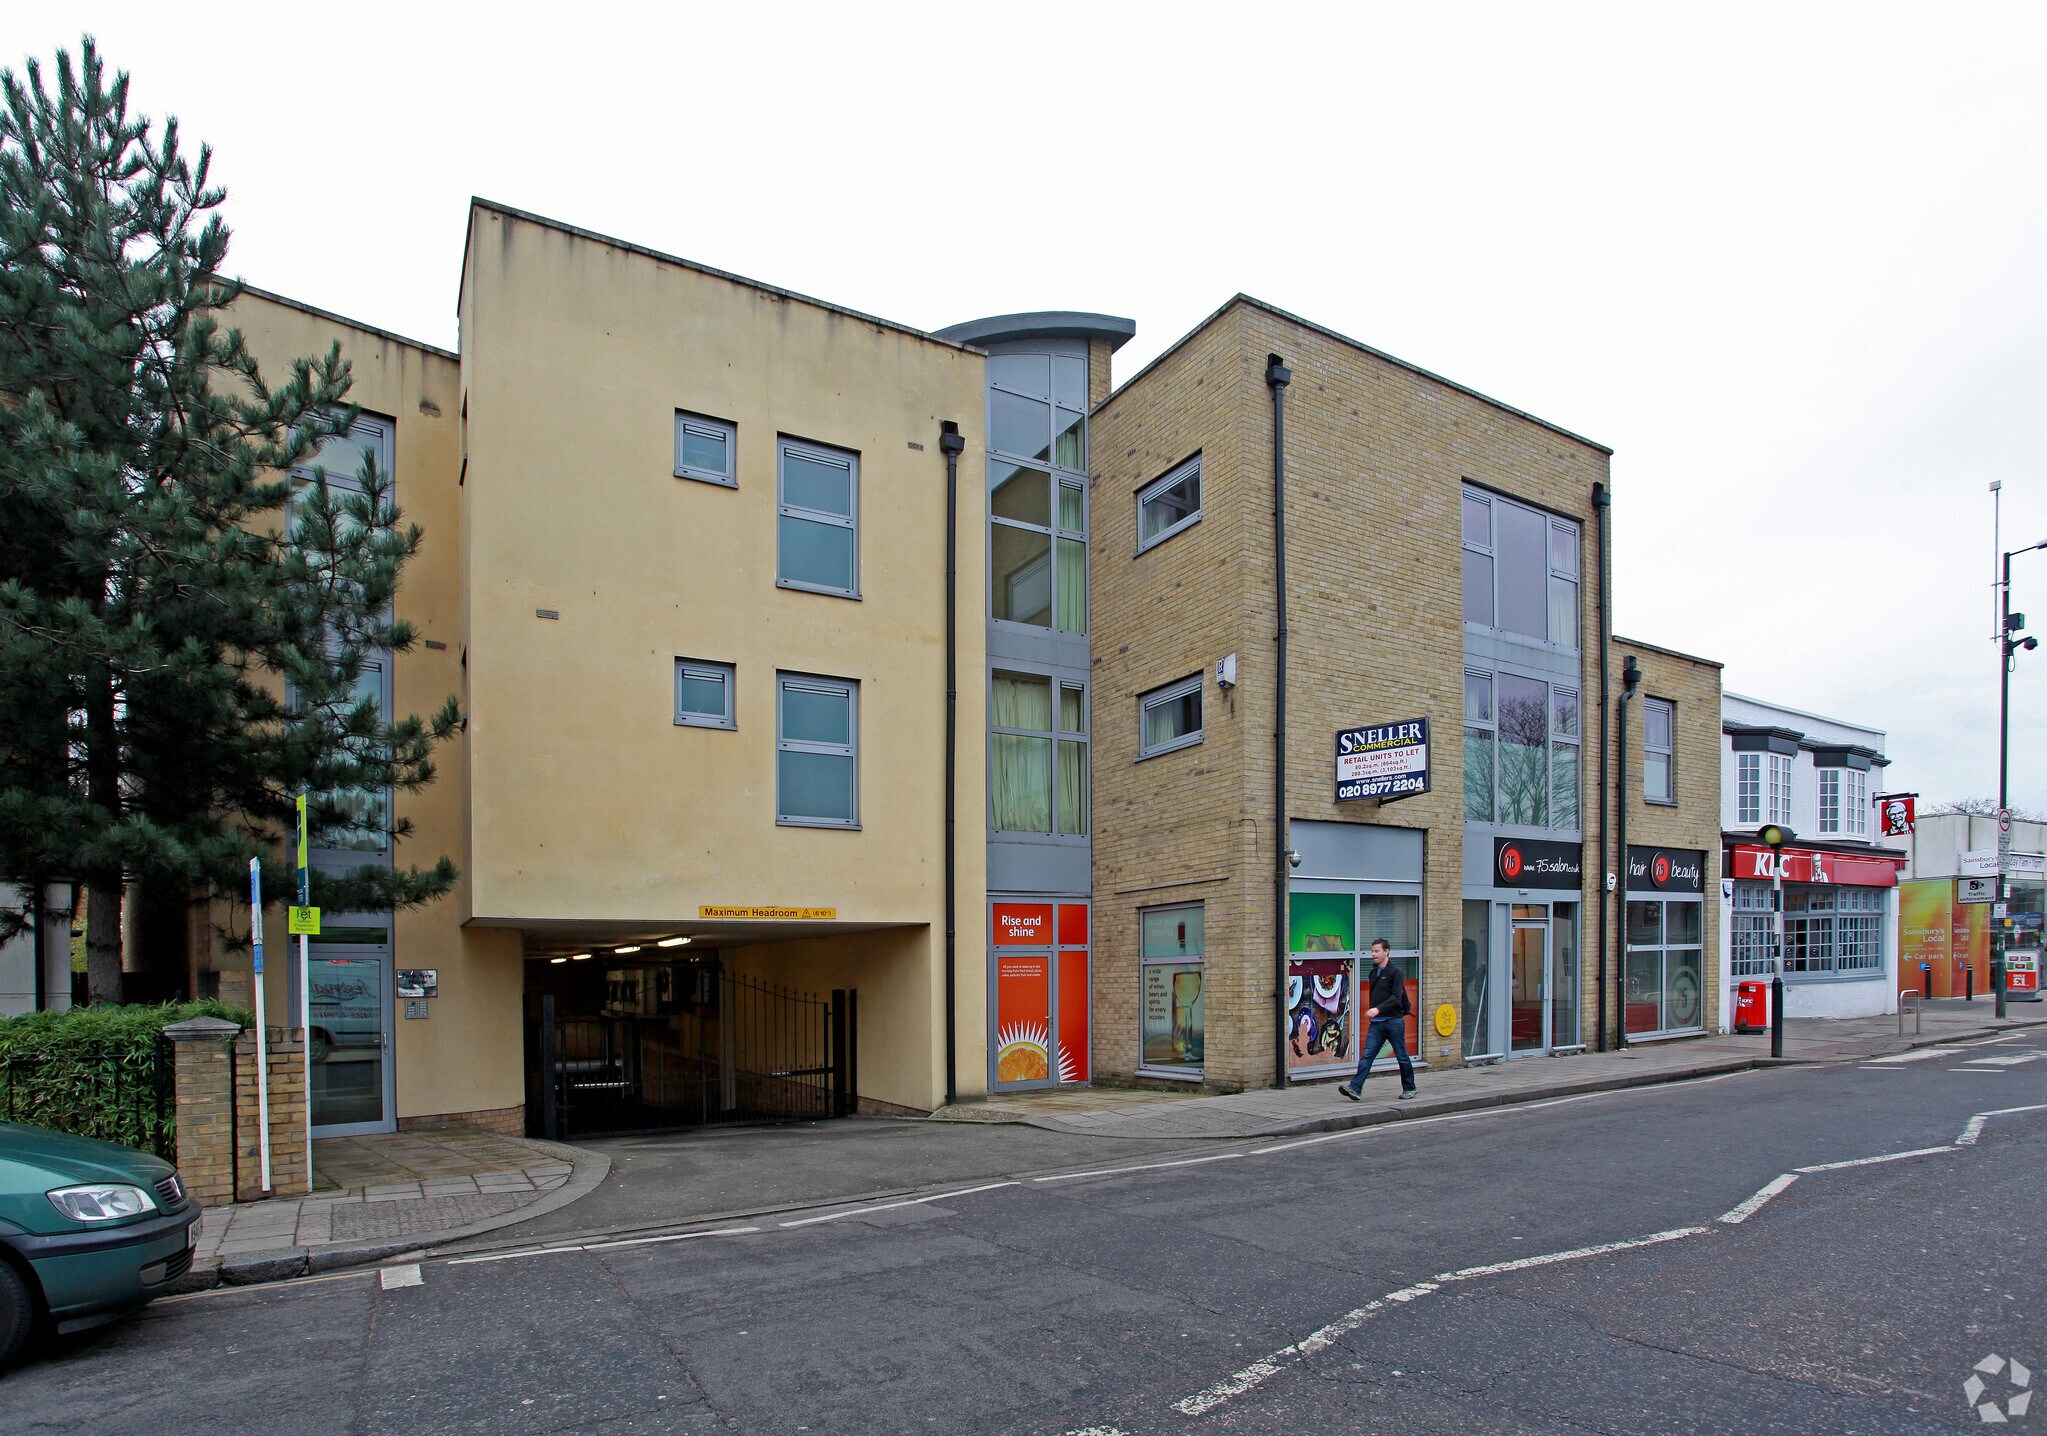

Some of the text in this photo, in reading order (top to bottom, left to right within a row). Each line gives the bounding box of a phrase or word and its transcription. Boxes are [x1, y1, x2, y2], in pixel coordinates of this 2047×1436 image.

[1340, 723, 1422, 754] SNELLER
[1353, 738, 1417, 752] COMMERCIAL
[1344, 755, 1368, 765] RETAIL
[1370, 752, 1392, 761] UNITS
[1405, 748, 1420, 756] LET
[1356, 774, 1407, 785] www.snellers.com
[1339, 777, 1424, 798] 020 8977 2204
[1629, 856, 1647, 877] hair
[1671, 859, 1699, 888] beauty
[704, 908, 749, 917] Maximum
[752, 908, 798, 917] Headroom
[1001, 915, 1042, 926] Rise and
[1009, 926, 1034, 937] shine
[1903, 927, 1945, 936] Sainsbury's
[2012, 977, 2026, 986] £1
